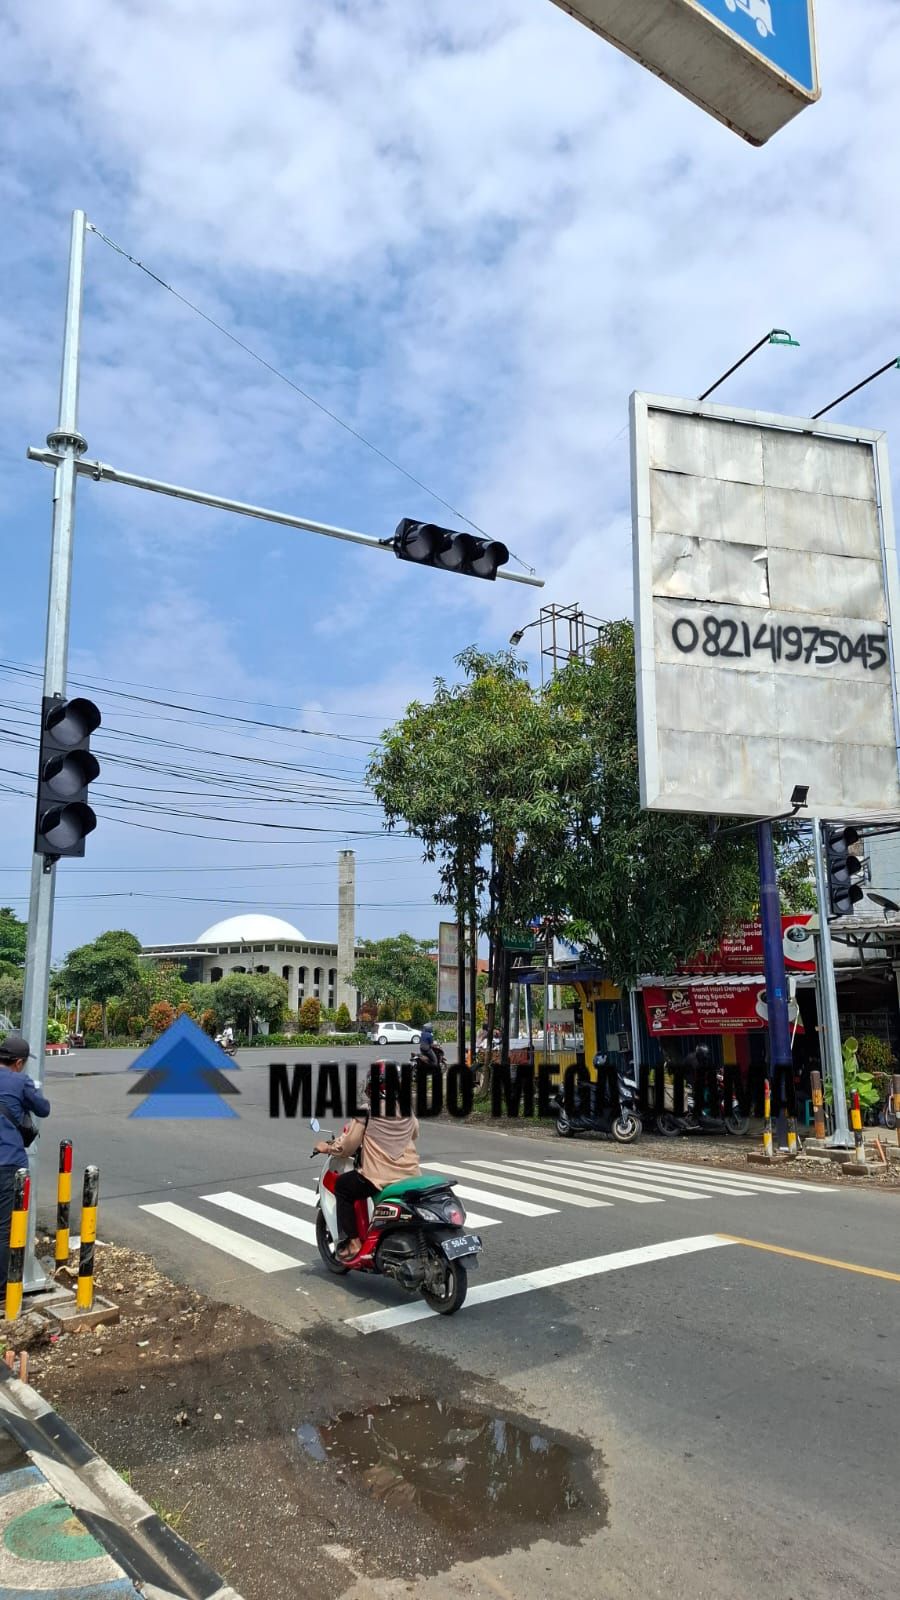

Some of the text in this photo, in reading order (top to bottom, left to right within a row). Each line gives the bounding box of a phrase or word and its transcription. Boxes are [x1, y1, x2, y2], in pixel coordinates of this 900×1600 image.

[671, 615, 889, 671] 082141975045
[724, 985, 750, 993] Dengan
[697, 1008, 716, 1016] Kapal
[717, 1007, 728, 1016] Api
